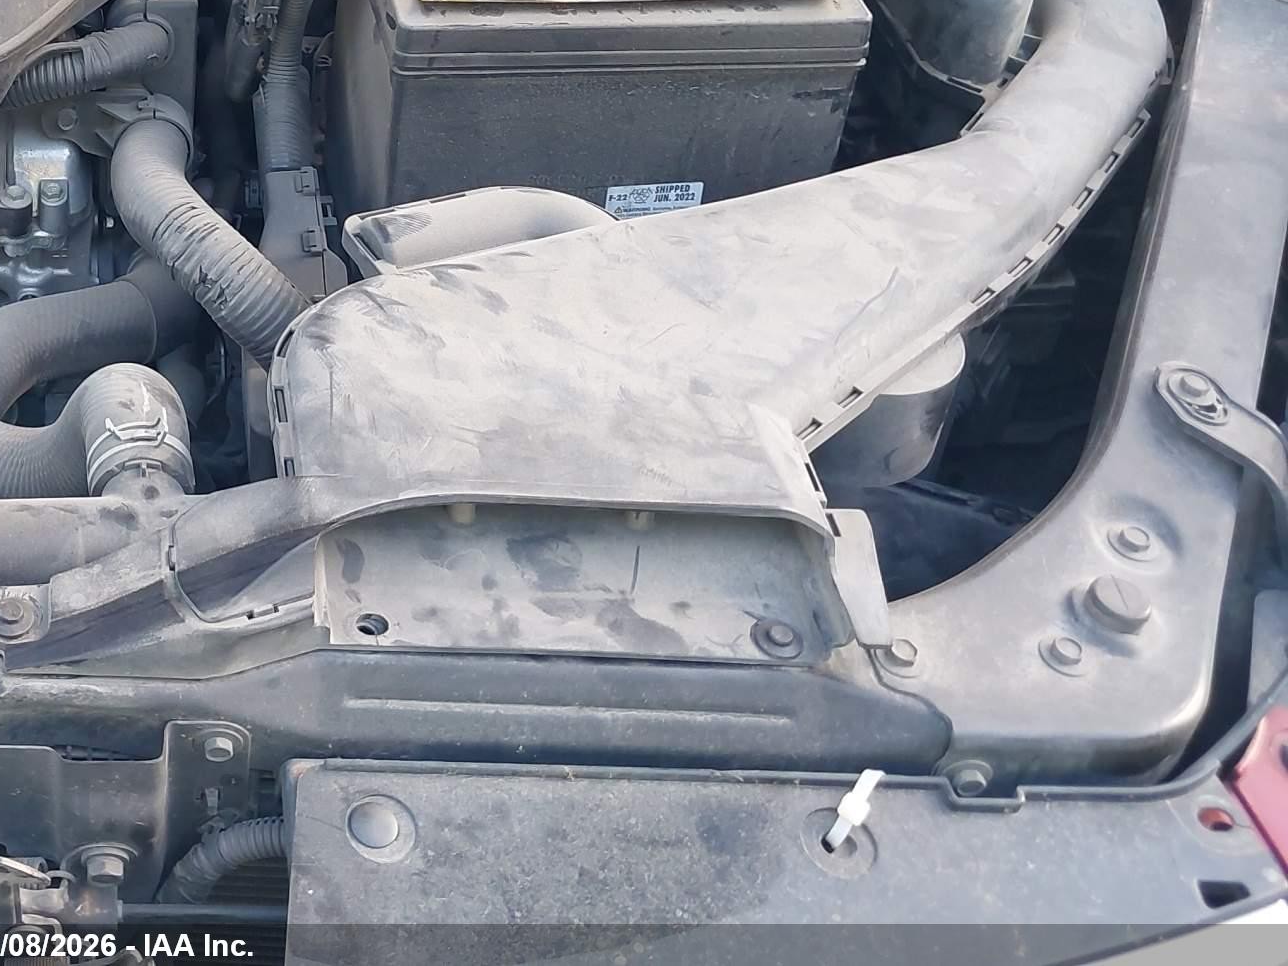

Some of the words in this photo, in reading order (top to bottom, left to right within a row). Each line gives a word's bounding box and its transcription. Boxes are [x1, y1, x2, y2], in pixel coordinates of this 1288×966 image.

[654, 184, 691, 194] SHIPPED
[653, 194, 672, 203] JUN.
[674, 192, 696, 202] 2022
